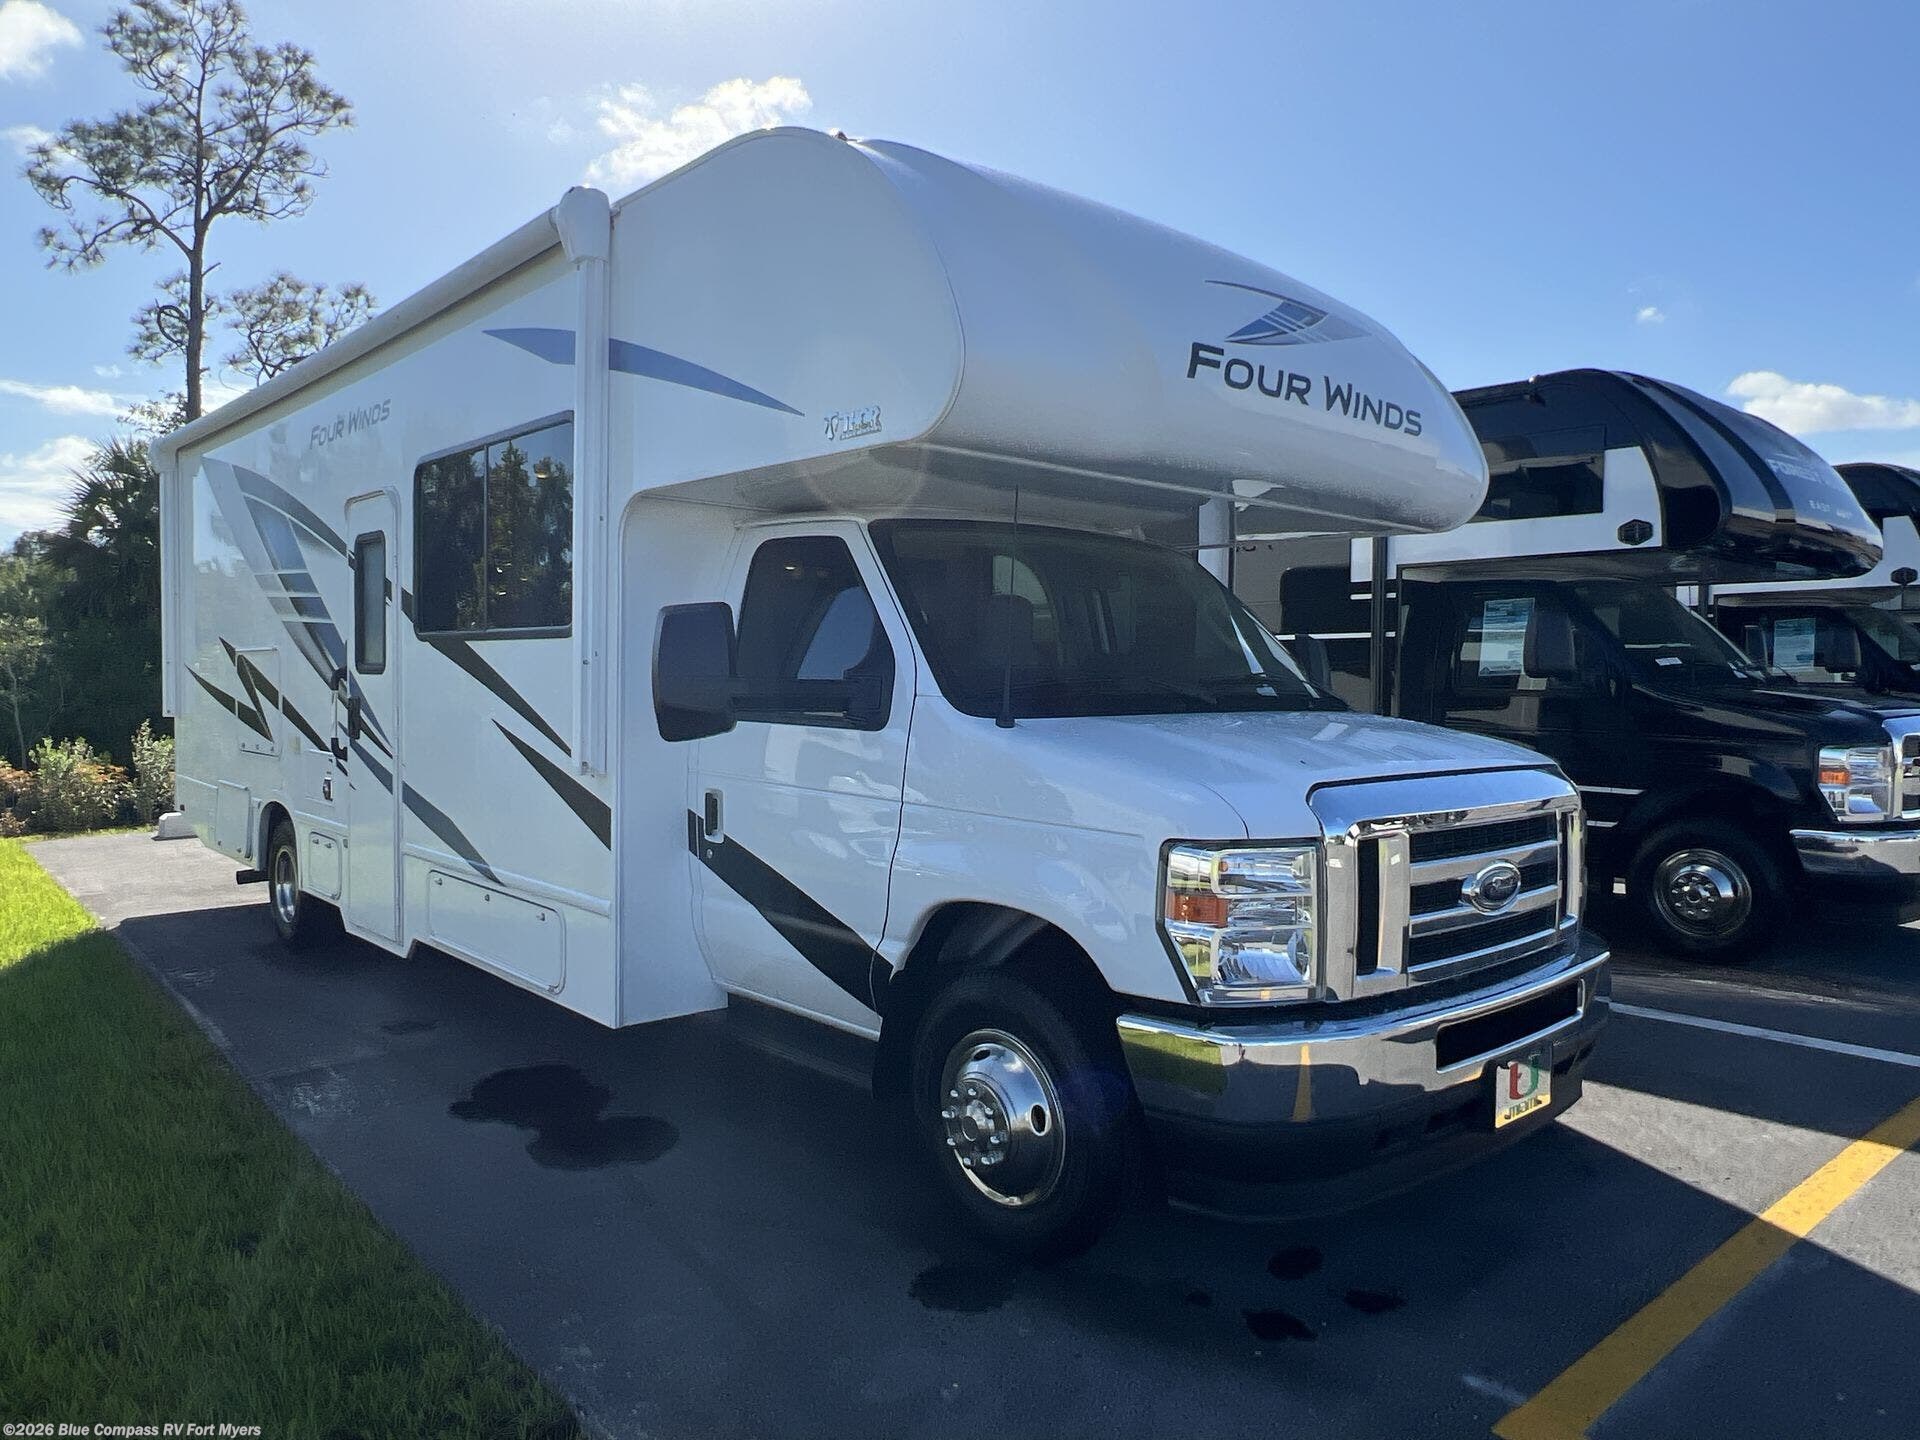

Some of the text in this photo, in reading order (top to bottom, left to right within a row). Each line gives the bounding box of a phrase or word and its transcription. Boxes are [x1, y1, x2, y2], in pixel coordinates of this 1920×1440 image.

[309, 398, 392, 450] FOUR WINDS
[1187, 342, 1423, 437] FOUR WINDS
